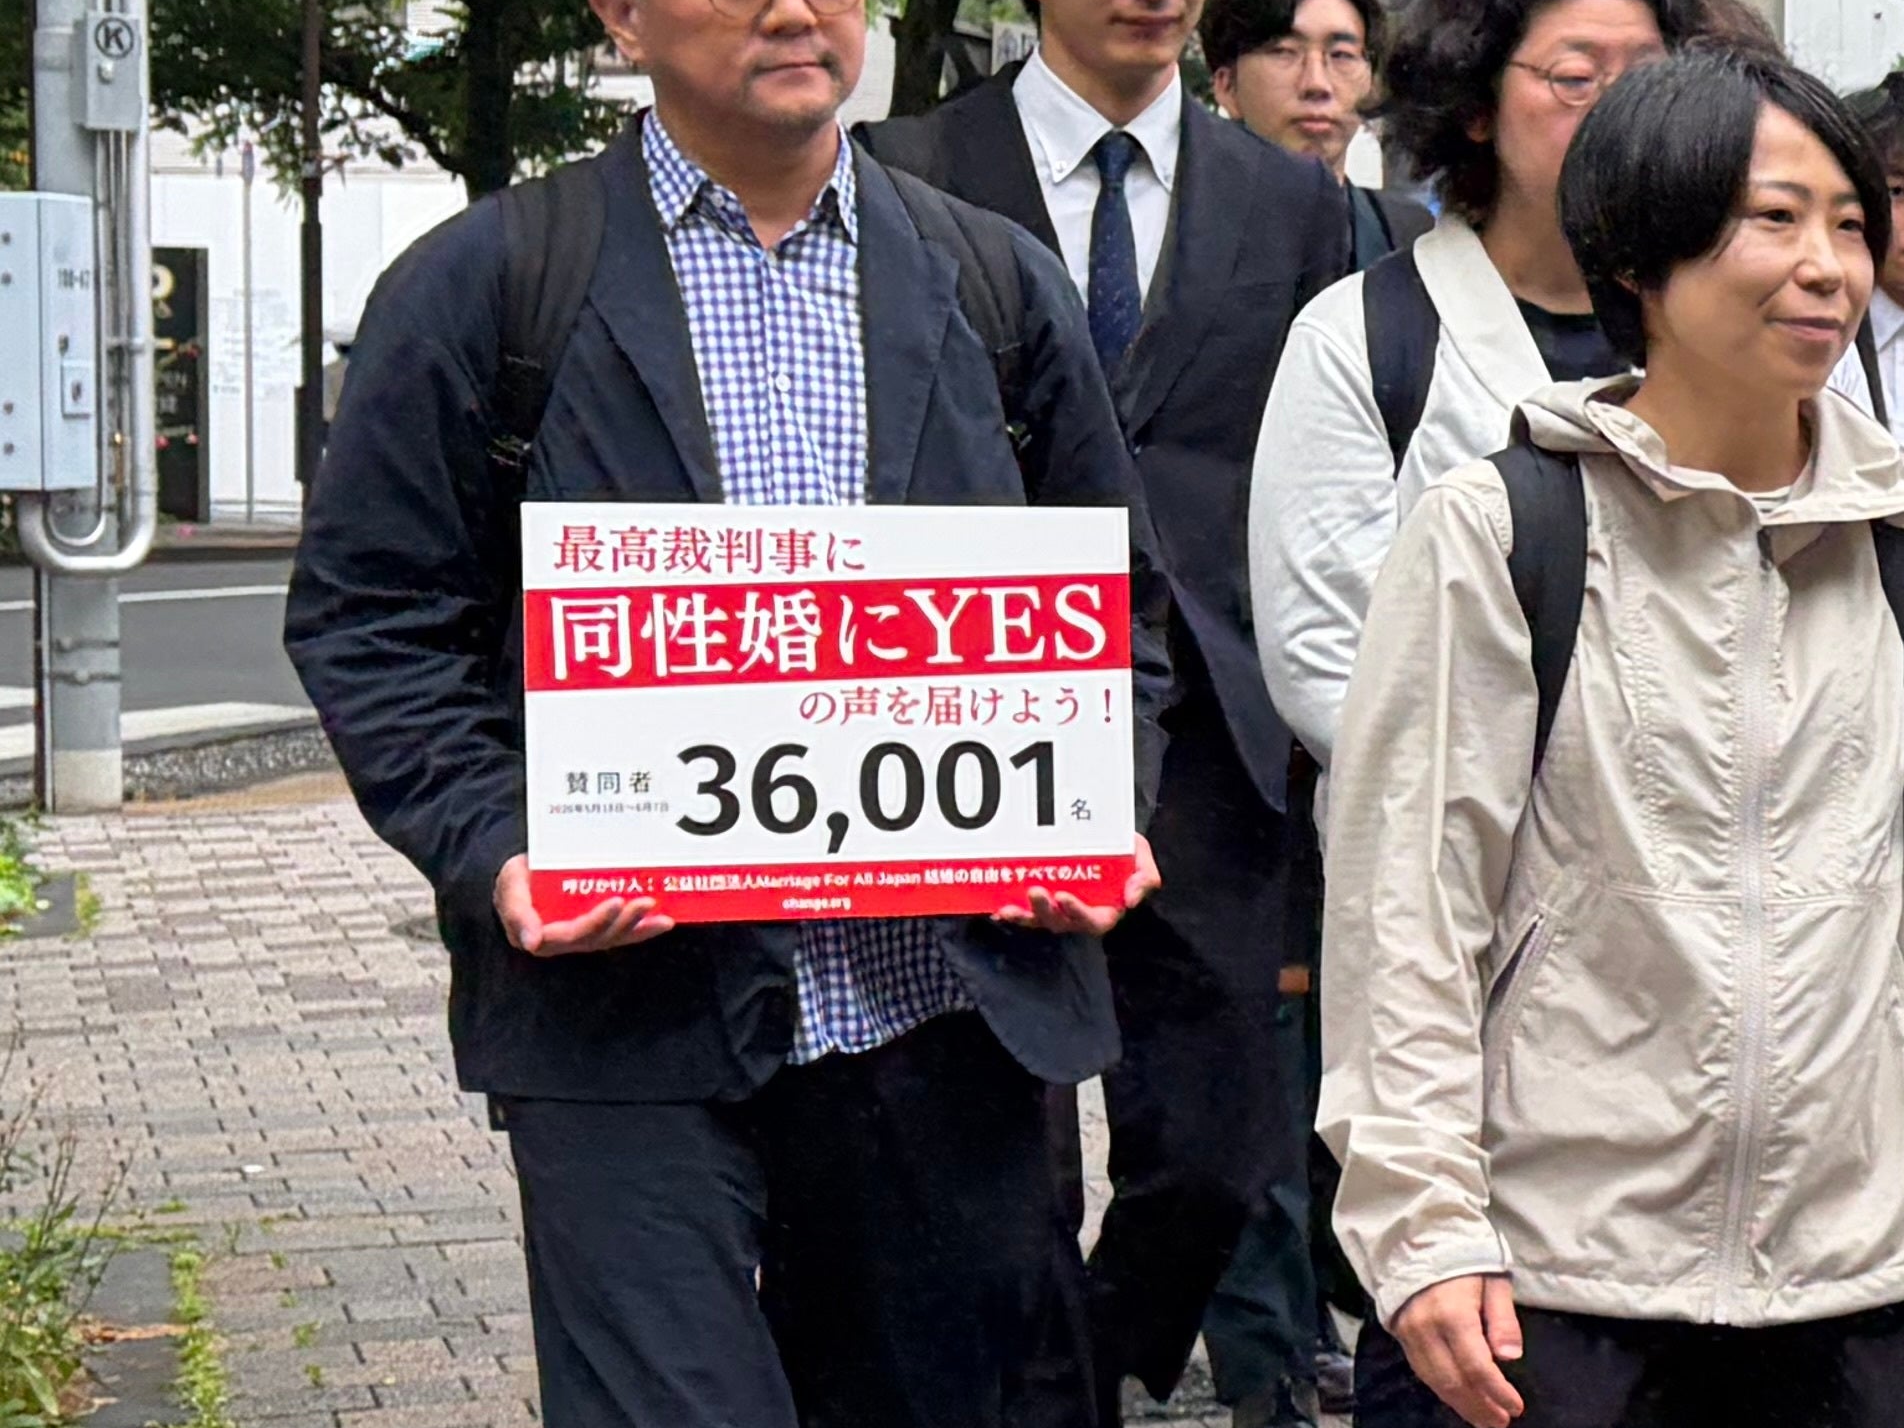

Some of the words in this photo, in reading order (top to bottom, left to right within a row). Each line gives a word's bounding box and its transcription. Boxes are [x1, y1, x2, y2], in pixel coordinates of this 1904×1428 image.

[553, 525, 867, 574] 最高裁判事に
[550, 583, 1107, 681] 同性婚にYES
[567, 770, 652, 795] 賛同者
[676, 740, 1056, 855] 36,001
[1070, 798, 1092, 821] 名
